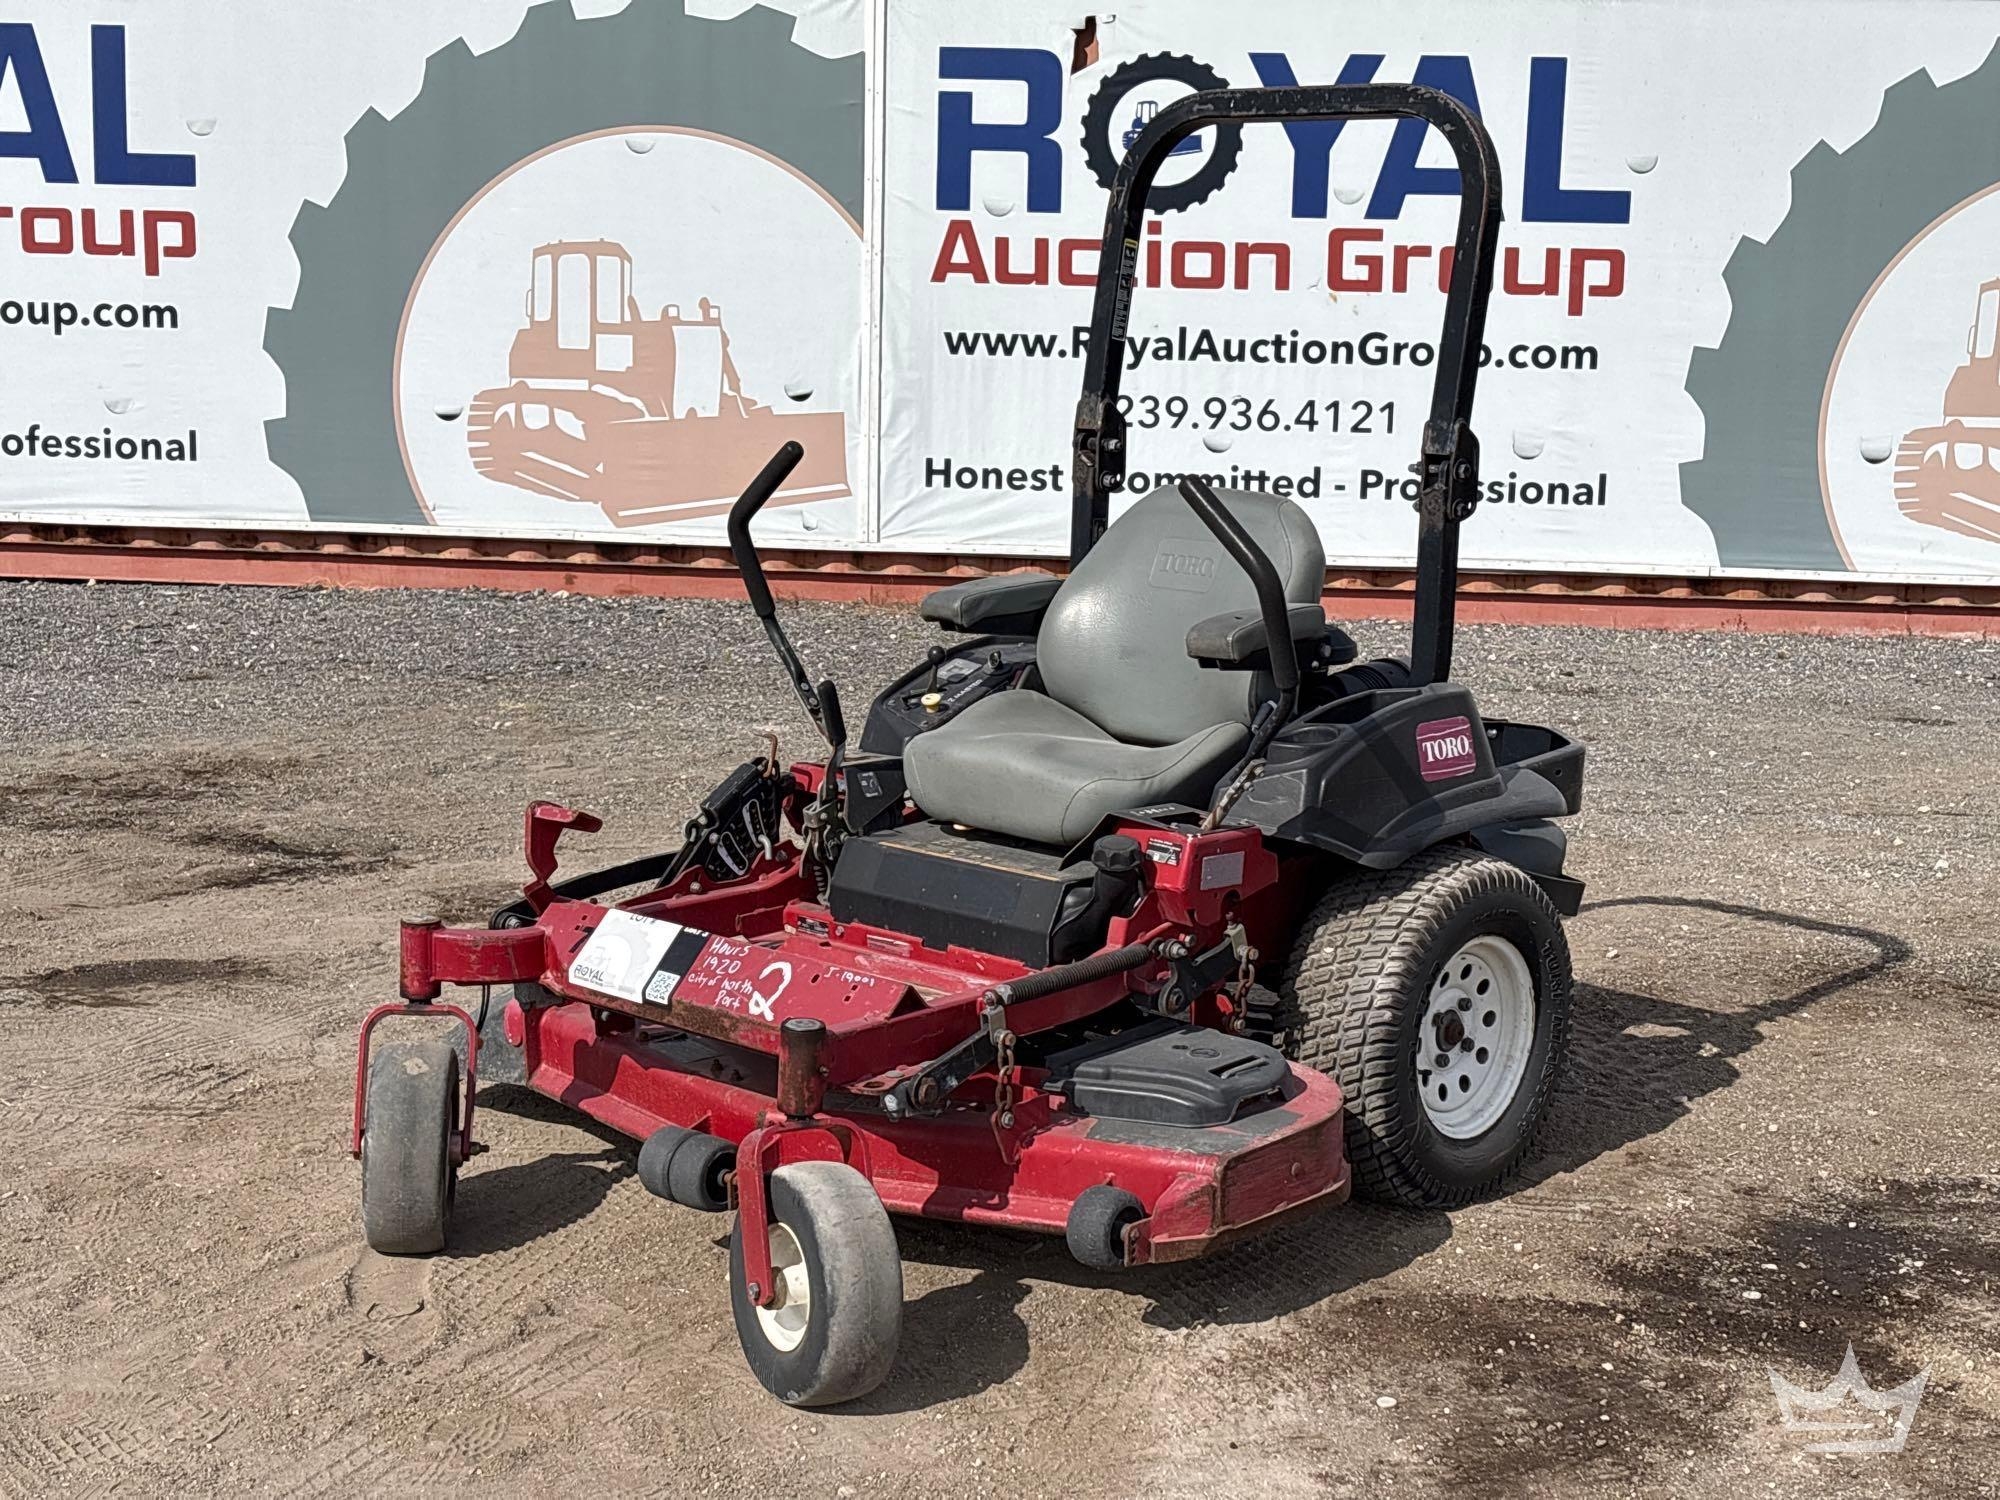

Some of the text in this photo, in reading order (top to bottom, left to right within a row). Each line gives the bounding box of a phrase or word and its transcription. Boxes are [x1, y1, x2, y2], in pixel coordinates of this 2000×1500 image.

[0, 206, 197, 277] oup
[930, 219, 1291, 291] Aucion
[943, 325, 1599, 371] www.RyalAuctionGro.com
[1116, 395, 1395, 434] 239.936.4121
[925, 457, 1064, 491] Honest
[1112, 465, 1322, 499] ommitted
[1358, 469, 1608, 507] Prosional
[1159, 552, 1215, 578] TORO
[1421, 734, 1470, 763] TORO
[702, 956, 742, 975] 1920
[709, 937, 753, 957] Hours
[573, 963, 605, 982] ROYAL
[748, 961, 792, 1021] 2
